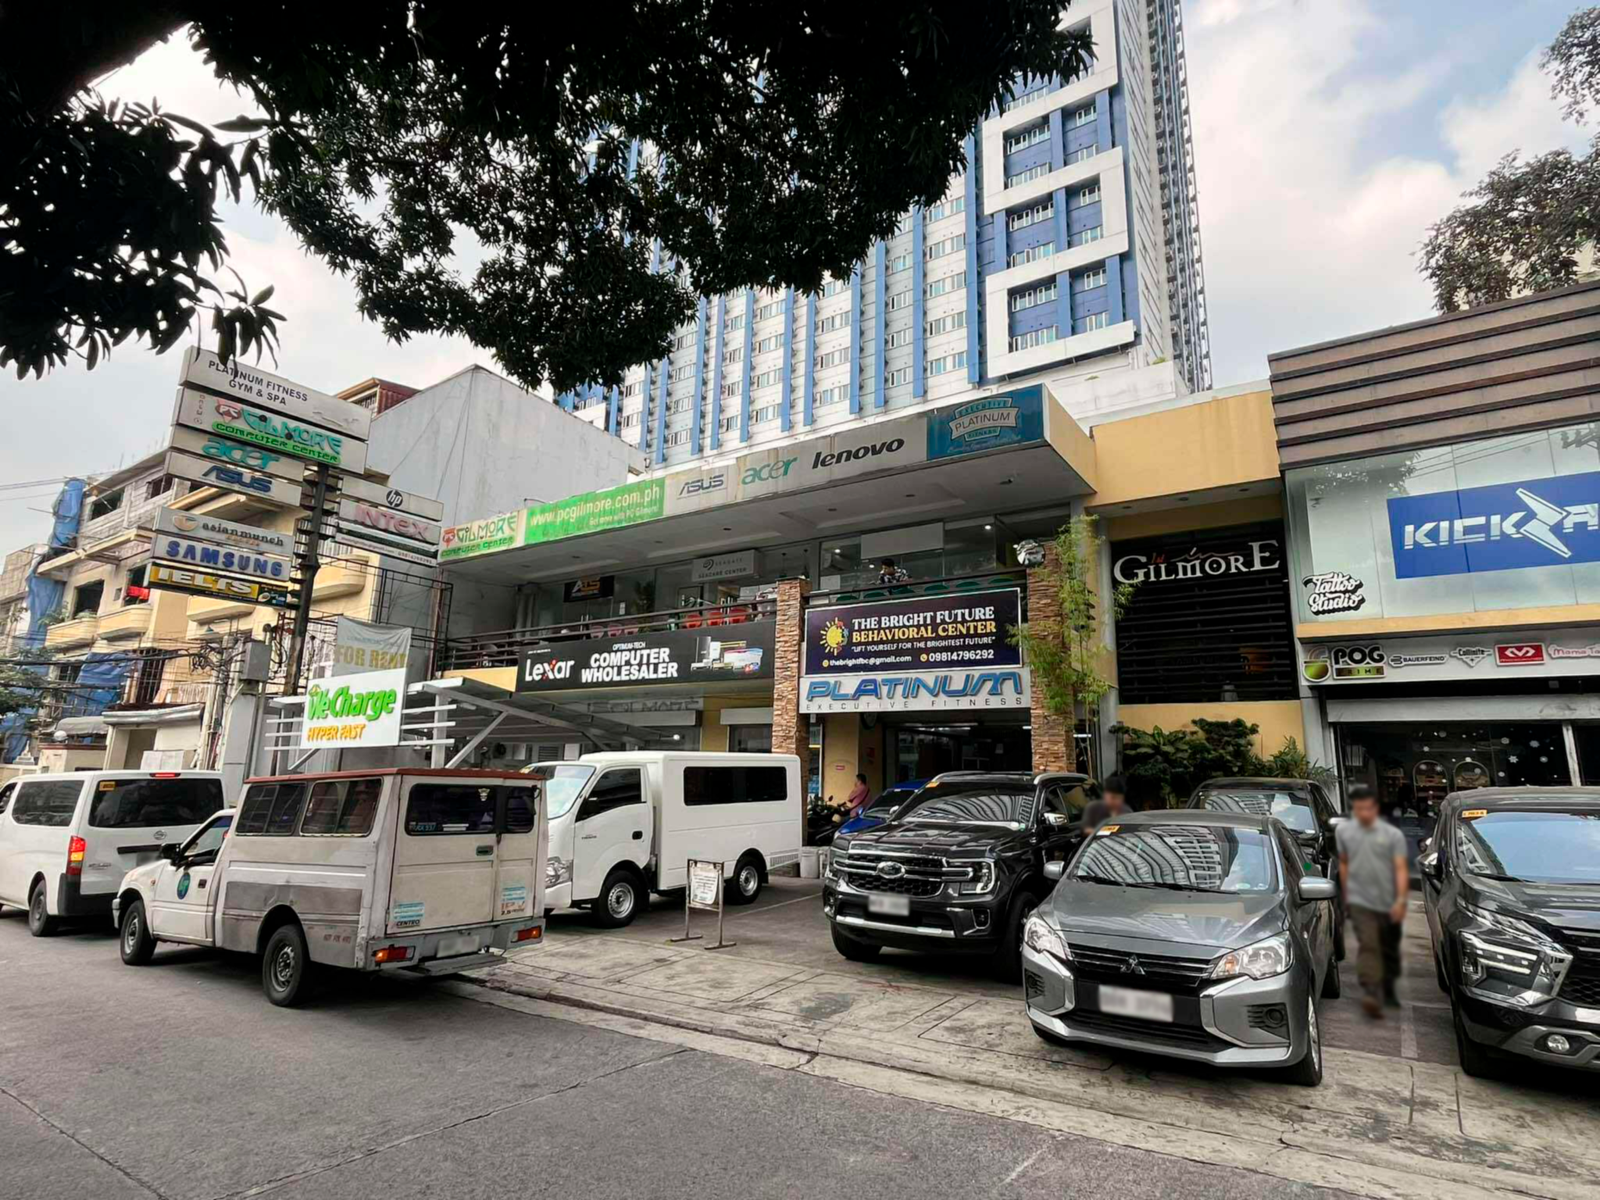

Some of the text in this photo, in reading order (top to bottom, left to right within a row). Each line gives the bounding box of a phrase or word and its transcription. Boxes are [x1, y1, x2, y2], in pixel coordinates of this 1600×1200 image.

[208, 360, 308, 402] PLATNUM FITNESS
[229, 379, 287, 406] GYM & SPA
[955, 412, 1010, 432] PLATINUM
[202, 437, 280, 470] acer
[216, 422, 338, 463] COMPUTER CENTER
[811, 437, 905, 470] lenovo
[202, 465, 273, 493] ASUS
[740, 456, 798, 485] acer
[679, 473, 725, 495] ASUS
[387, 490, 403, 508] hp
[530, 483, 660, 525] www.pcgilmore.com.ph
[456, 515, 517, 543] GILMORE
[441, 536, 514, 556] COMPUTER CENTER
[166, 540, 283, 577] SAMSUNG
[159, 567, 252, 594] IELTS
[1302, 572, 1363, 594] Tattoo
[1308, 592, 1366, 615] Studio
[852, 606, 995, 630] THE BRIGHT FUTURE
[852, 621, 997, 643] BEHAVIORAL CENTER
[335, 644, 366, 667] FOR
[867, 642, 898, 652] YOURSELF
[899, 641, 912, 650] FOR
[914, 640, 926, 649] THE
[927, 638, 965, 648] BRIGHTEST
[928, 649, 994, 662] 09814796292
[1333, 646, 1386, 665] POG
[590, 647, 670, 668] COMPUTER
[525, 658, 575, 682] Lexar
[581, 662, 679, 683] WHOLESALER
[1337, 666, 1383, 676] RIME
[806, 671, 1022, 701] PLATINUM
[806, 697, 1022, 711] EXECUTIVE FITNESS
[307, 724, 366, 742] HYPER FAST
